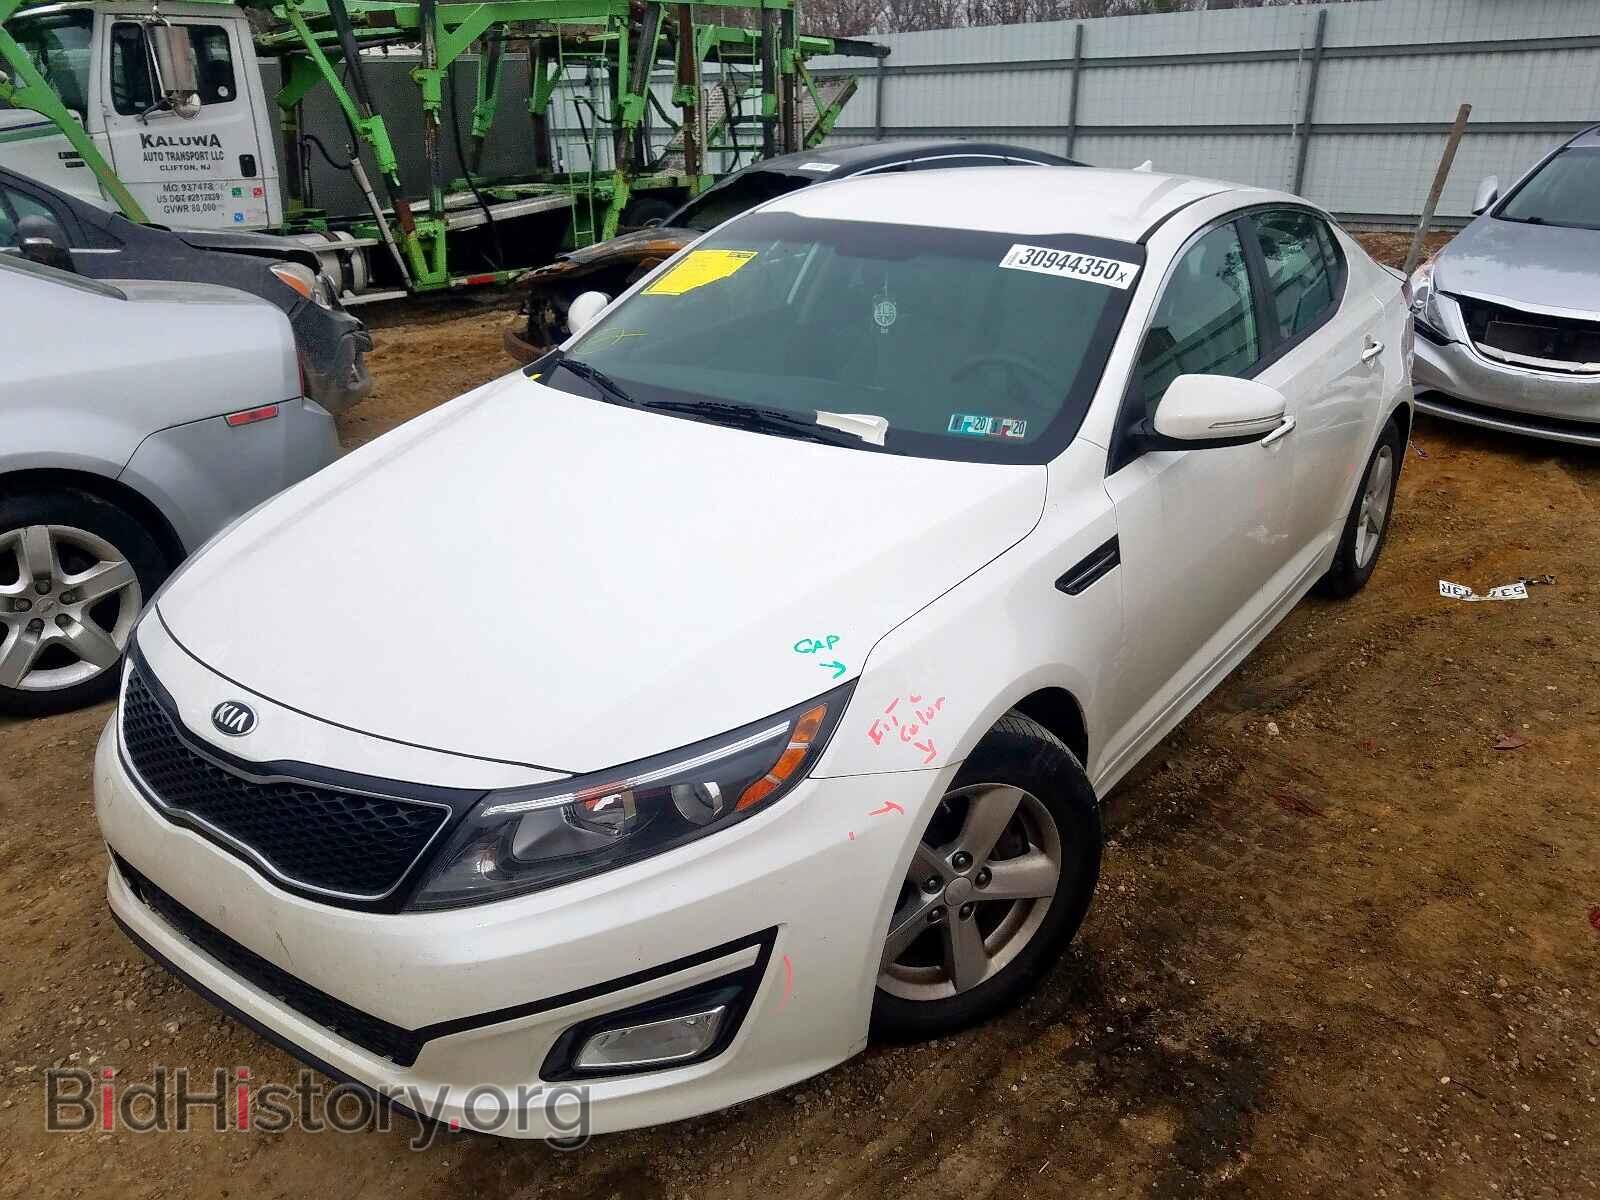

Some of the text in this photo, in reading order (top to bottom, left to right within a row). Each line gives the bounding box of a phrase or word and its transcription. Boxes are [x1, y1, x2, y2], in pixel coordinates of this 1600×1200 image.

[139, 133, 222, 149] KALUWA
[143, 151, 224, 162] AUTO TRANSPORT LLC
[163, 204, 189, 213] GVWR
[975, 417, 986, 430] 20
[1013, 421, 1024, 434] 20
[214, 702, 249, 732] KIA
